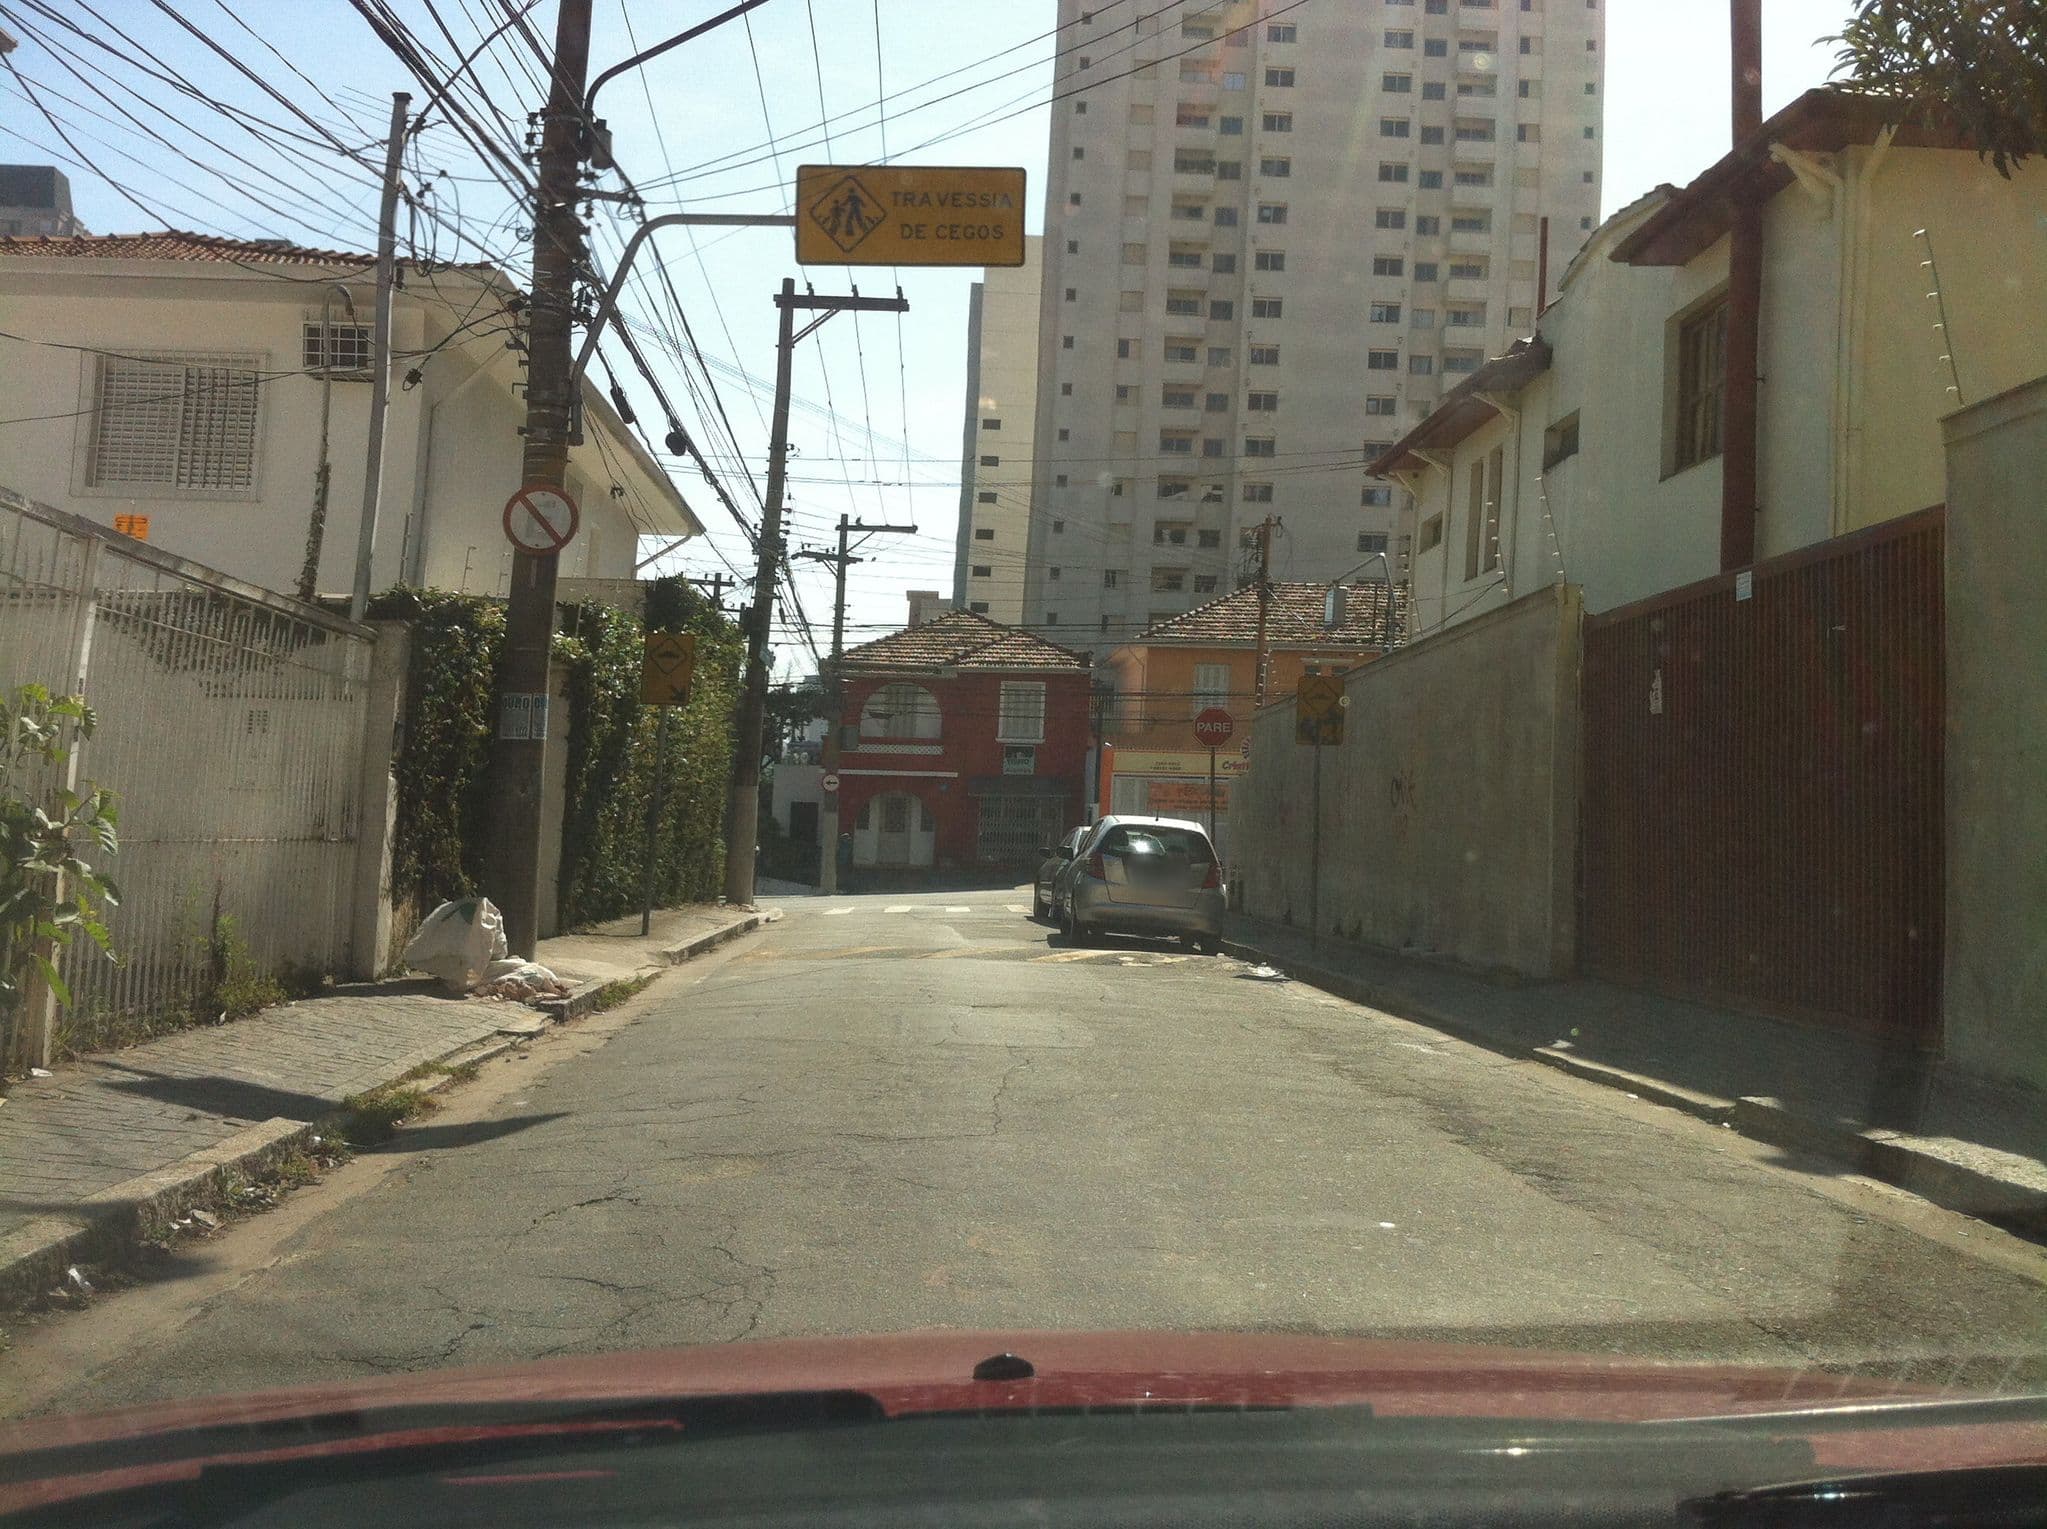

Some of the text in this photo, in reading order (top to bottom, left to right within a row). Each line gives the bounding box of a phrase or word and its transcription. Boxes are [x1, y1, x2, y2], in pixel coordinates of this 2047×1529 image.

[891, 191, 1013, 208] TRAVESSIA
[900, 224, 1005, 240] DE CEGOS
[1197, 722, 1231, 733] PARE
